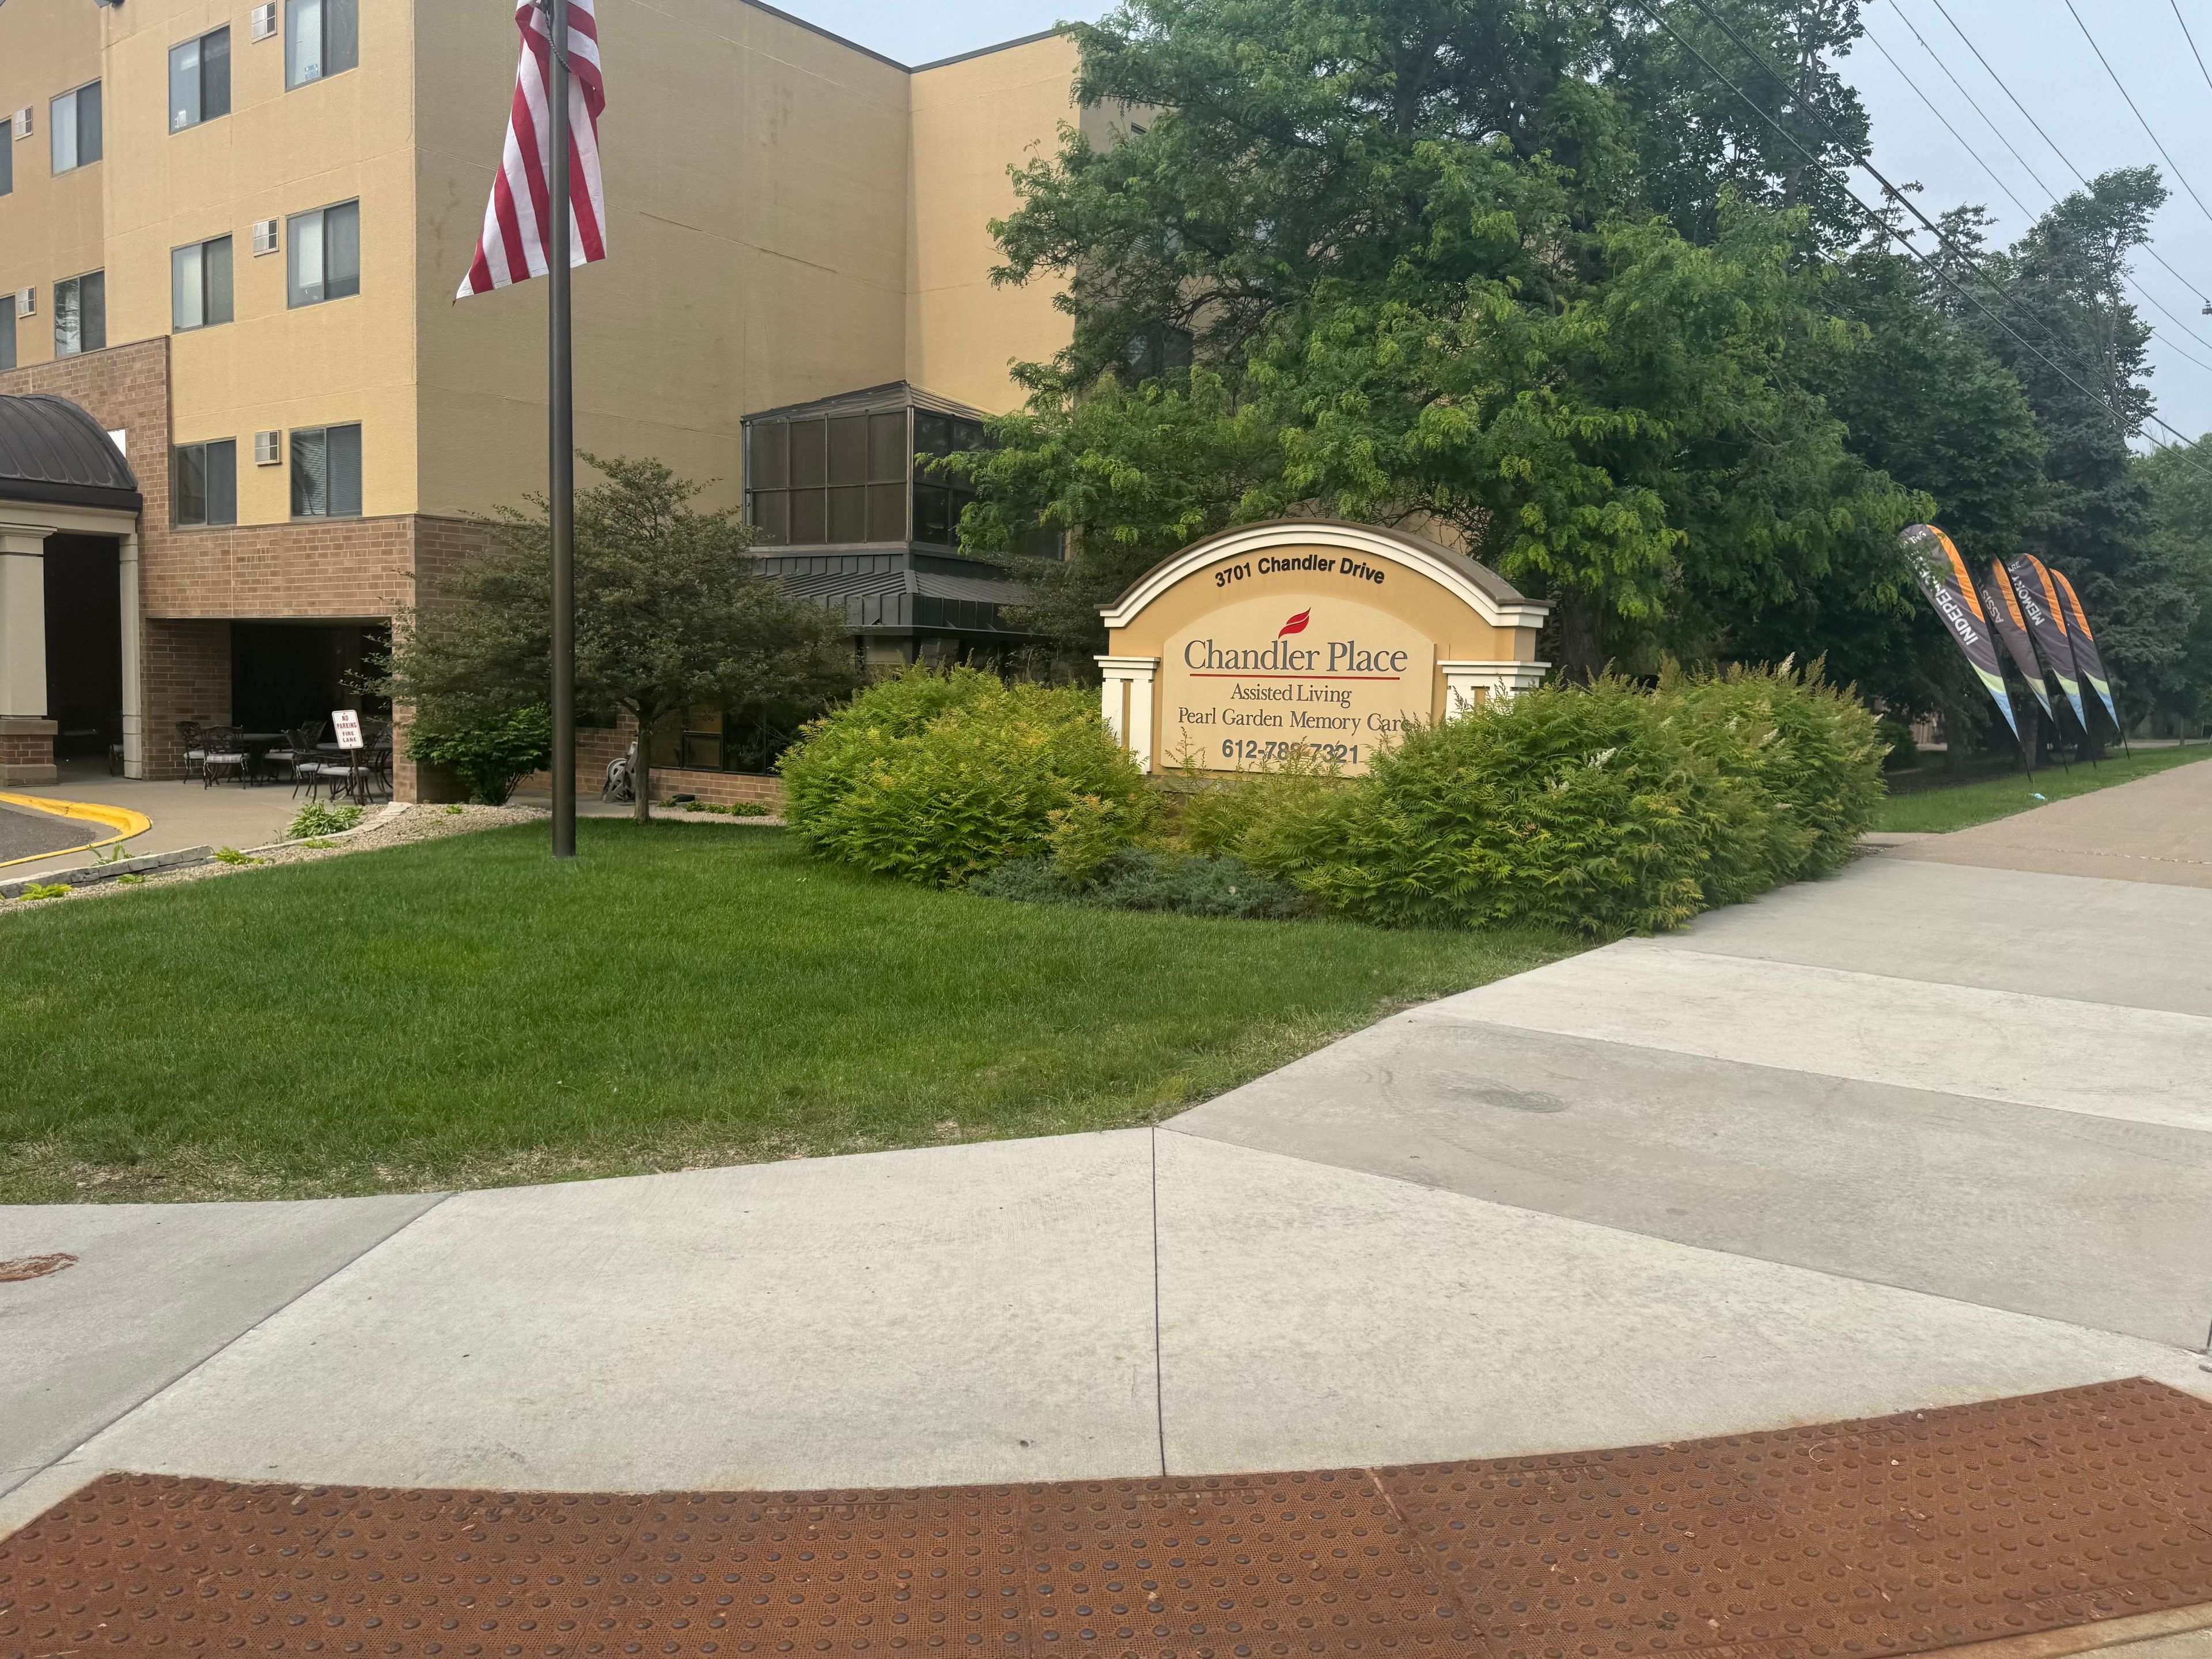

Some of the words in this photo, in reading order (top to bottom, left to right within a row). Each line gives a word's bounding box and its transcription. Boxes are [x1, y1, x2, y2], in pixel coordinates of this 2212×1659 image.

[1215, 562, 1251, 588] 3701
[1257, 554, 1336, 575] Chandler
[1339, 557, 1385, 585] Drive
[2007, 560, 2021, 573] ARE
[2012, 575, 2046, 626] MEMORY
[1184, 639, 1320, 671] Chandler
[1325, 640, 1408, 672] Place
[1230, 683, 1293, 702] Assisted
[1296, 684, 1353, 709] Living
[1177, 707, 1217, 725] Pearl
[1222, 708, 1283, 728] Garden
[1289, 710, 1362, 737] Memory
[1222, 738, 1358, 765] 612-787321
